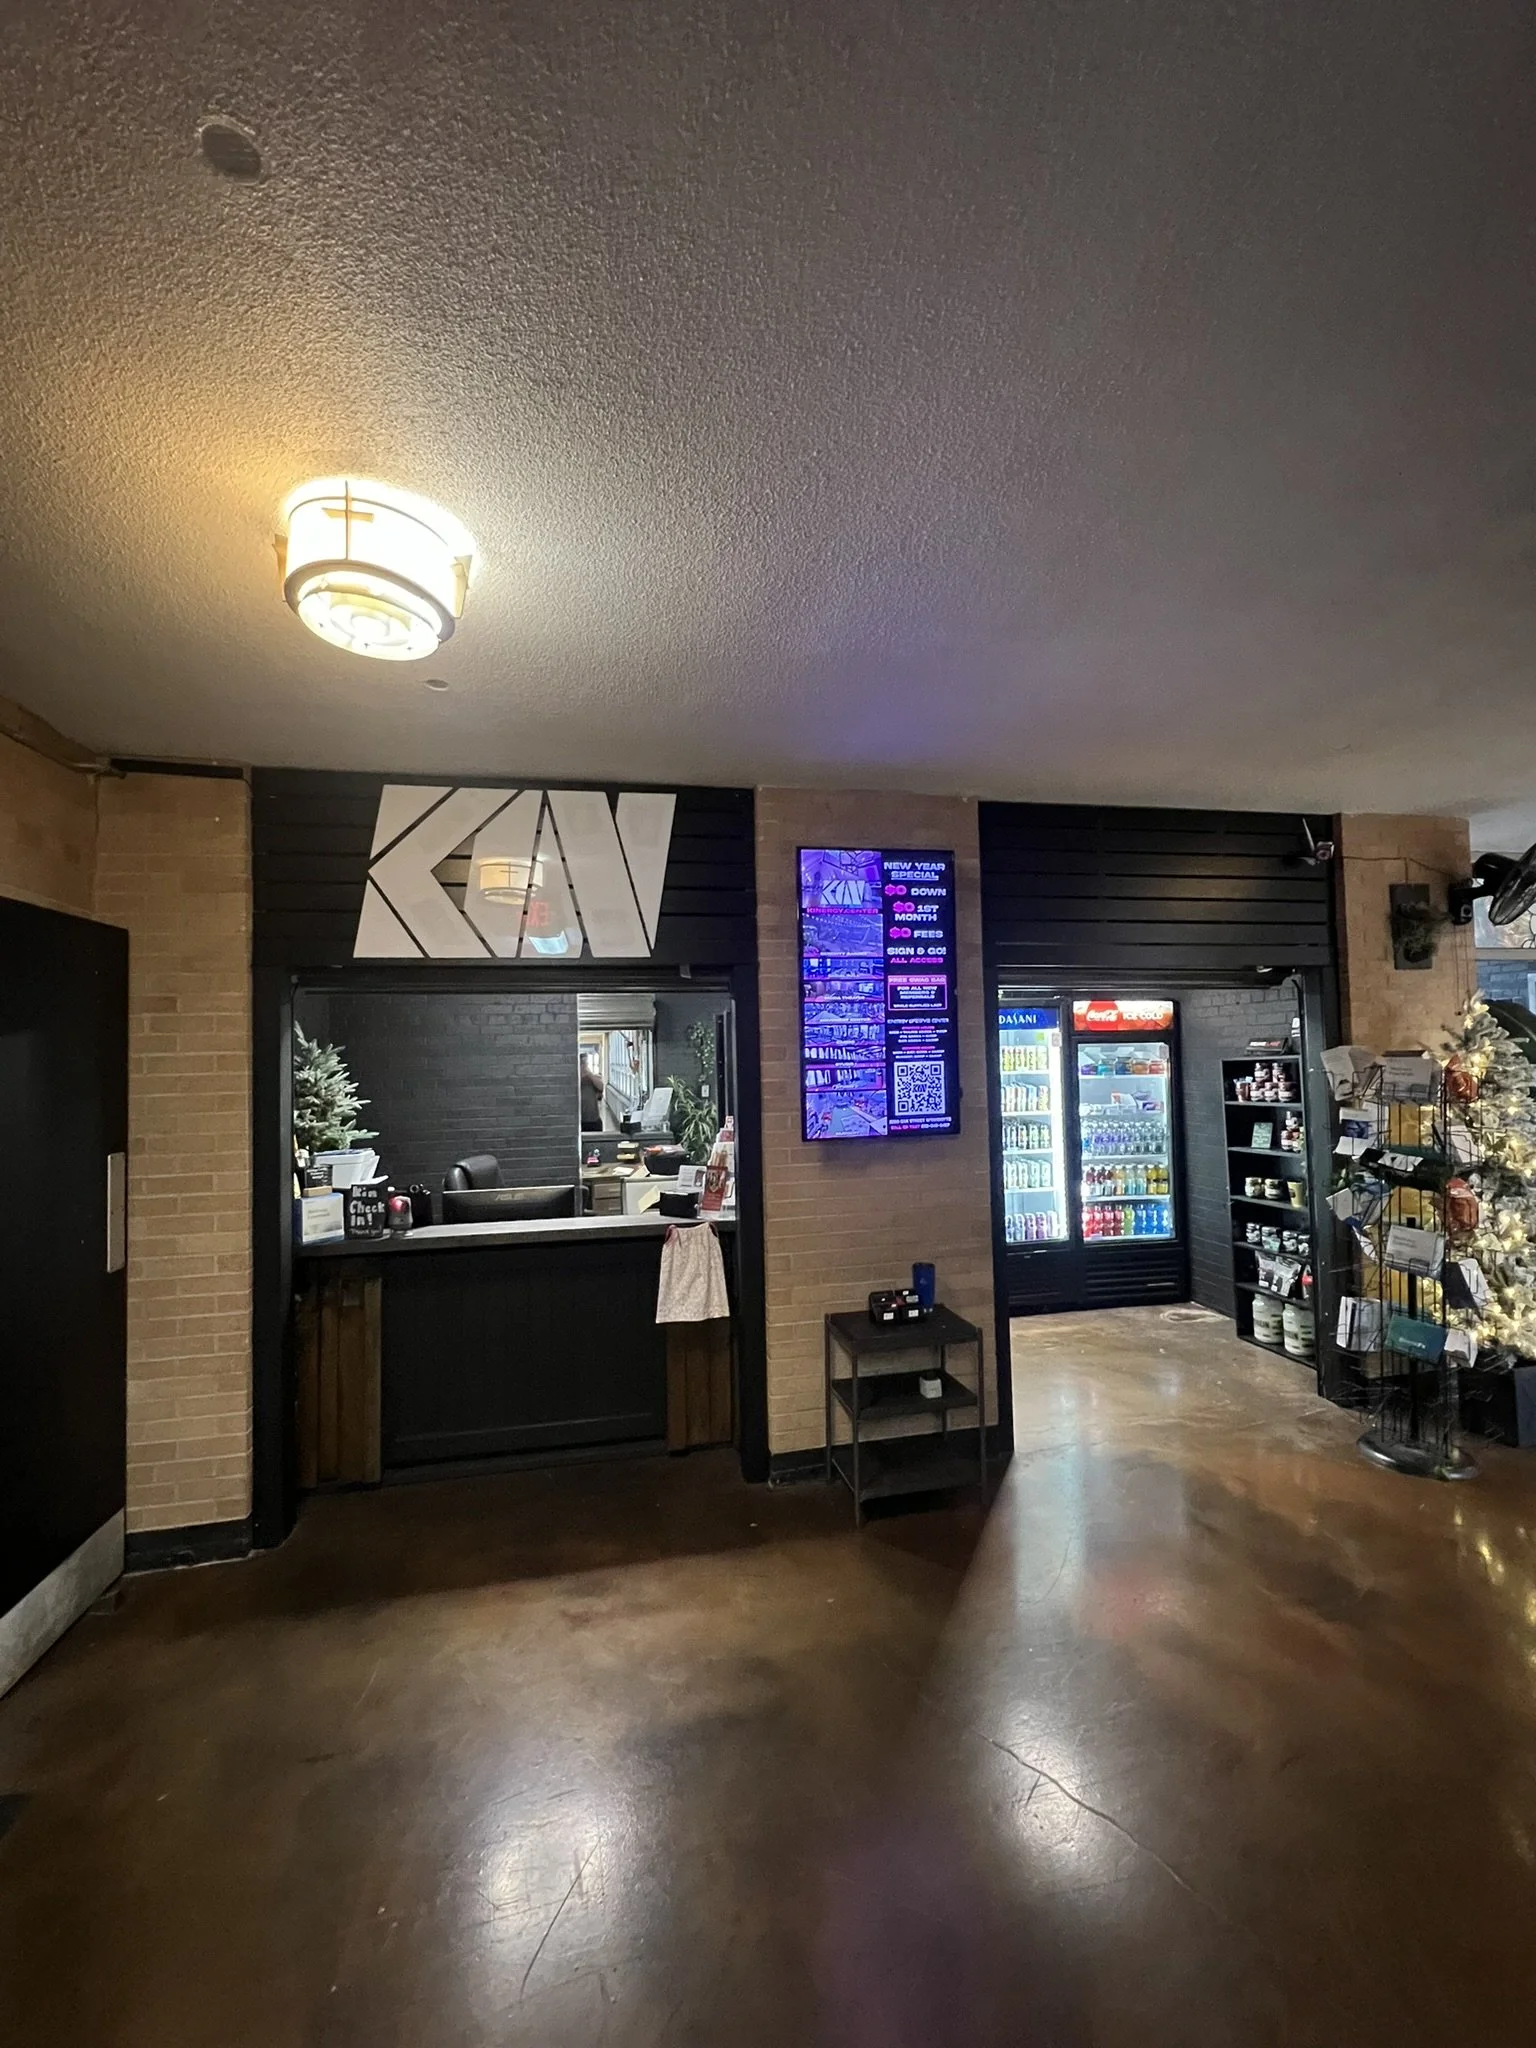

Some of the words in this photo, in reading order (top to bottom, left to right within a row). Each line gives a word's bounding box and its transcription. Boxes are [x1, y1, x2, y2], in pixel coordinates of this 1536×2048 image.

[884, 862, 911, 870] NEW
[915, 862, 945, 871] YEAR
[891, 871, 938, 879] SPECIAL
[884, 884, 907, 896] $0
[911, 888, 946, 896] DOWN
[893, 901, 915, 912] $0
[889, 927, 911, 938] $0
[914, 930, 943, 938] FEES
[887, 947, 914, 955] SIGN
[927, 947, 946, 955] GO!
[999, 1012, 1036, 1024] DASANI
[350, 1200, 385, 1214] Check
